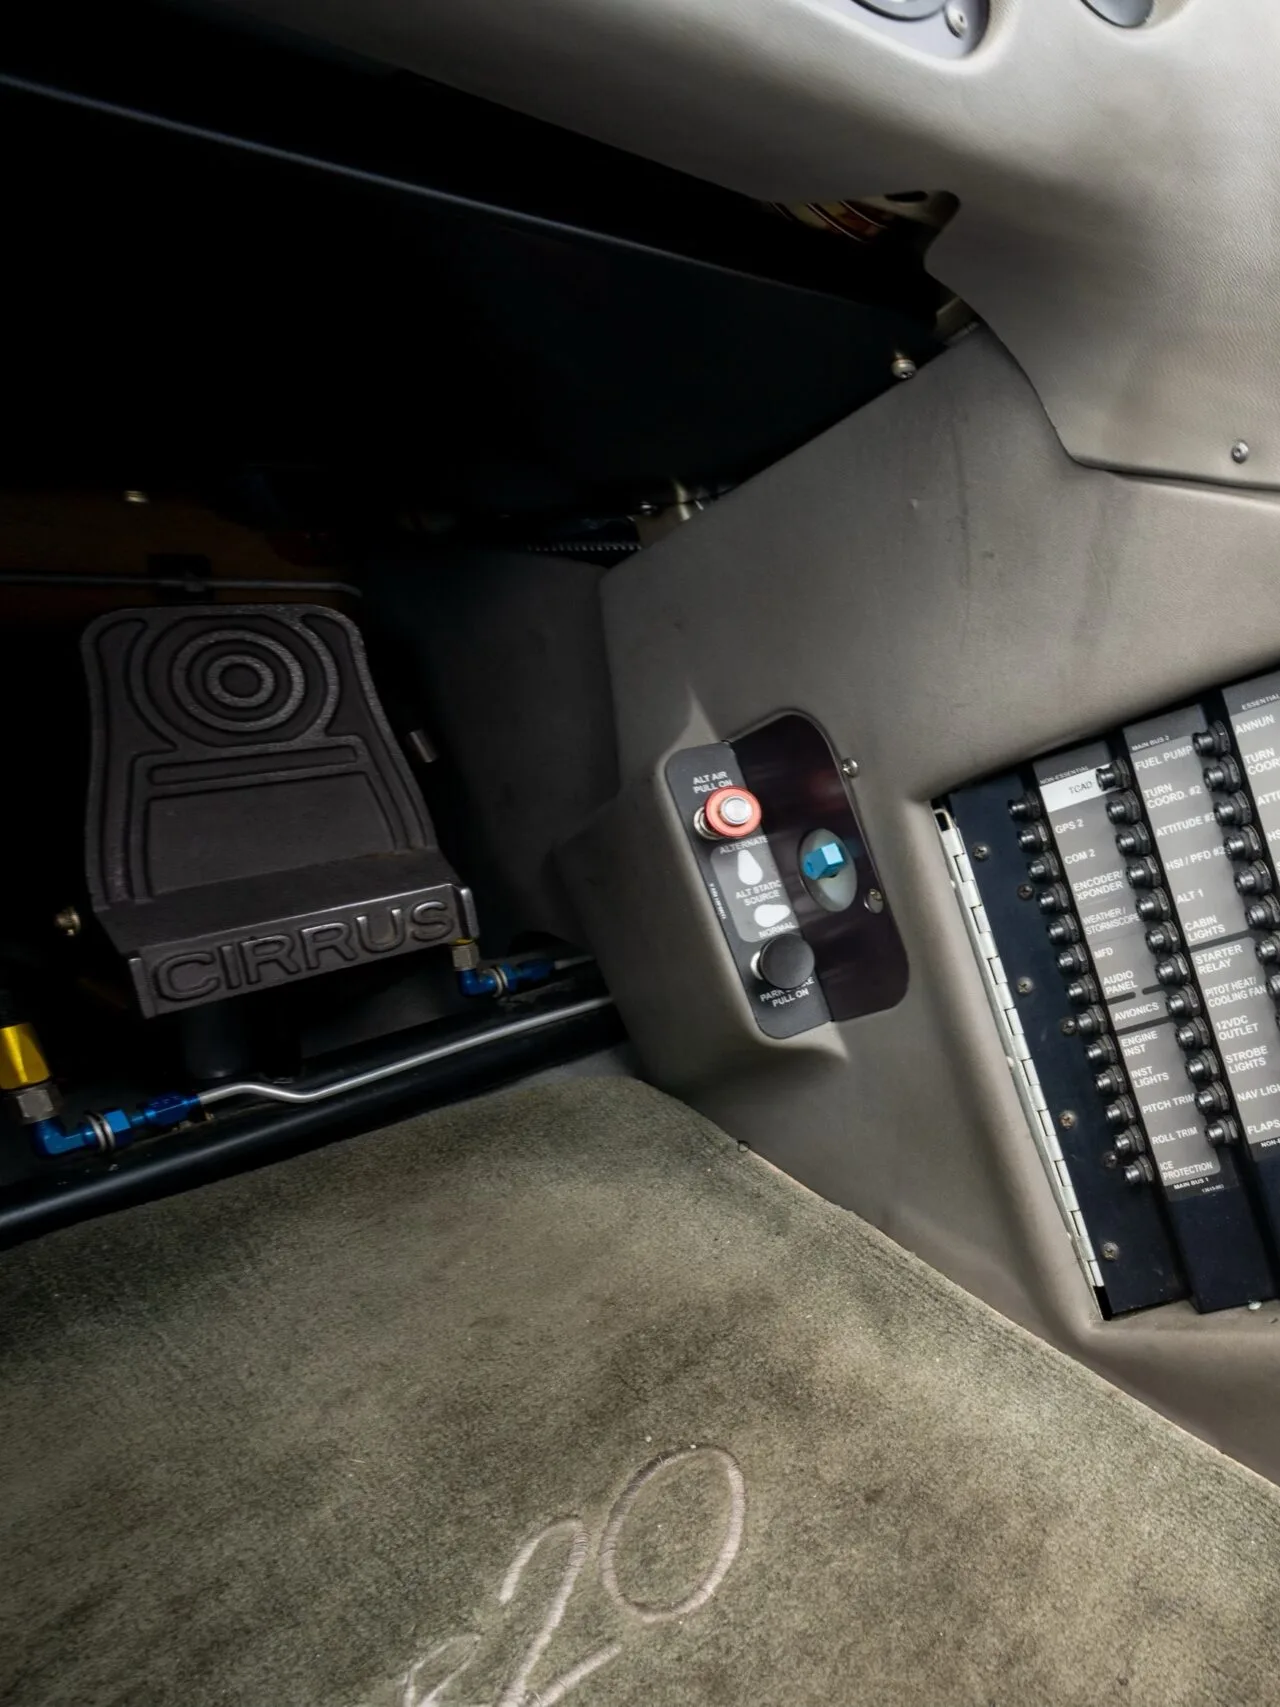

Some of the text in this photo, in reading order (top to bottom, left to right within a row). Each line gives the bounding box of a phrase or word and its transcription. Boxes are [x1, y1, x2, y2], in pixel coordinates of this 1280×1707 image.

[1241, 693, 1280, 711] ESSENTIAL
[1235, 714, 1275, 735] ANNUN
[1132, 742, 1149, 751] MAIN
[1150, 738, 1163, 747] BUS
[1134, 745, 1194, 772] FUEL PUMP
[1244, 748, 1275, 765] TURN
[693, 771, 728, 785] ALT AIR
[1040, 765, 1089, 785] NON-ESSENTIAL
[693, 779, 733, 794] PULL ON
[1069, 781, 1092, 795] TCAD
[1144, 783, 1173, 800] TURN
[1189, 785, 1202, 796] #2
[1055, 818, 1085, 835] GPS 2
[1156, 812, 1216, 838] ATTITUDE #2
[719, 835, 769, 854] ALTERNATE
[1064, 849, 1096, 865] COM 2
[1165, 858, 1184, 871] HSI
[1190, 850, 1212, 865] PFD
[1213, 845, 1225, 857] #2
[736, 880, 782, 899] ALT STATIC
[1072, 869, 1124, 892] ENCODER/
[744, 890, 780, 906] SOURCE
[1076, 881, 1124, 902] XPONDER
[1176, 891, 1198, 905] ALT
[1082, 908, 1122, 925] WEATHER
[1085, 912, 1140, 936] STORMSCOPE
[1184, 915, 1218, 932] CABIN
[758, 922, 797, 938] NORMAL
[1188, 924, 1226, 942] LIGHTS
[153, 900, 455, 1004] CIRRUS
[1093, 946, 1114, 960] MFD
[1194, 944, 1244, 966] STARTER
[1198, 958, 1233, 977] RELAY
[1103, 970, 1134, 986] AUDIO
[1105, 980, 1139, 997] PANEL
[1204, 976, 1258, 999] PITOT HEAT/
[1207, 984, 1267, 1009] COOLING FAN
[771, 988, 810, 1007] PULL ON
[1114, 1001, 1160, 1022] AVIONICS
[1215, 1014, 1249, 1031] 12VDC
[1120, 1030, 1159, 1048] ENGINE
[1218, 1023, 1259, 1042] OUTLET
[1124, 1044, 1147, 1057] INST
[1225, 1045, 1269, 1065] STROBE
[1131, 1065, 1153, 1079] INST
[1228, 1056, 1267, 1075] LIGHTS
[1133, 1072, 1170, 1089] LIGHTS
[1142, 1092, 1196, 1115] PITCH TRIM
[1237, 1088, 1261, 1103] NAV
[1152, 1126, 1198, 1146] ROLL TRIM
[1159, 1160, 1175, 1172] ICE
[1162, 1161, 1214, 1182] PROTECTION
[1173, 1180, 1192, 1190] MAIN
[1193, 1178, 1206, 1187] BUS
